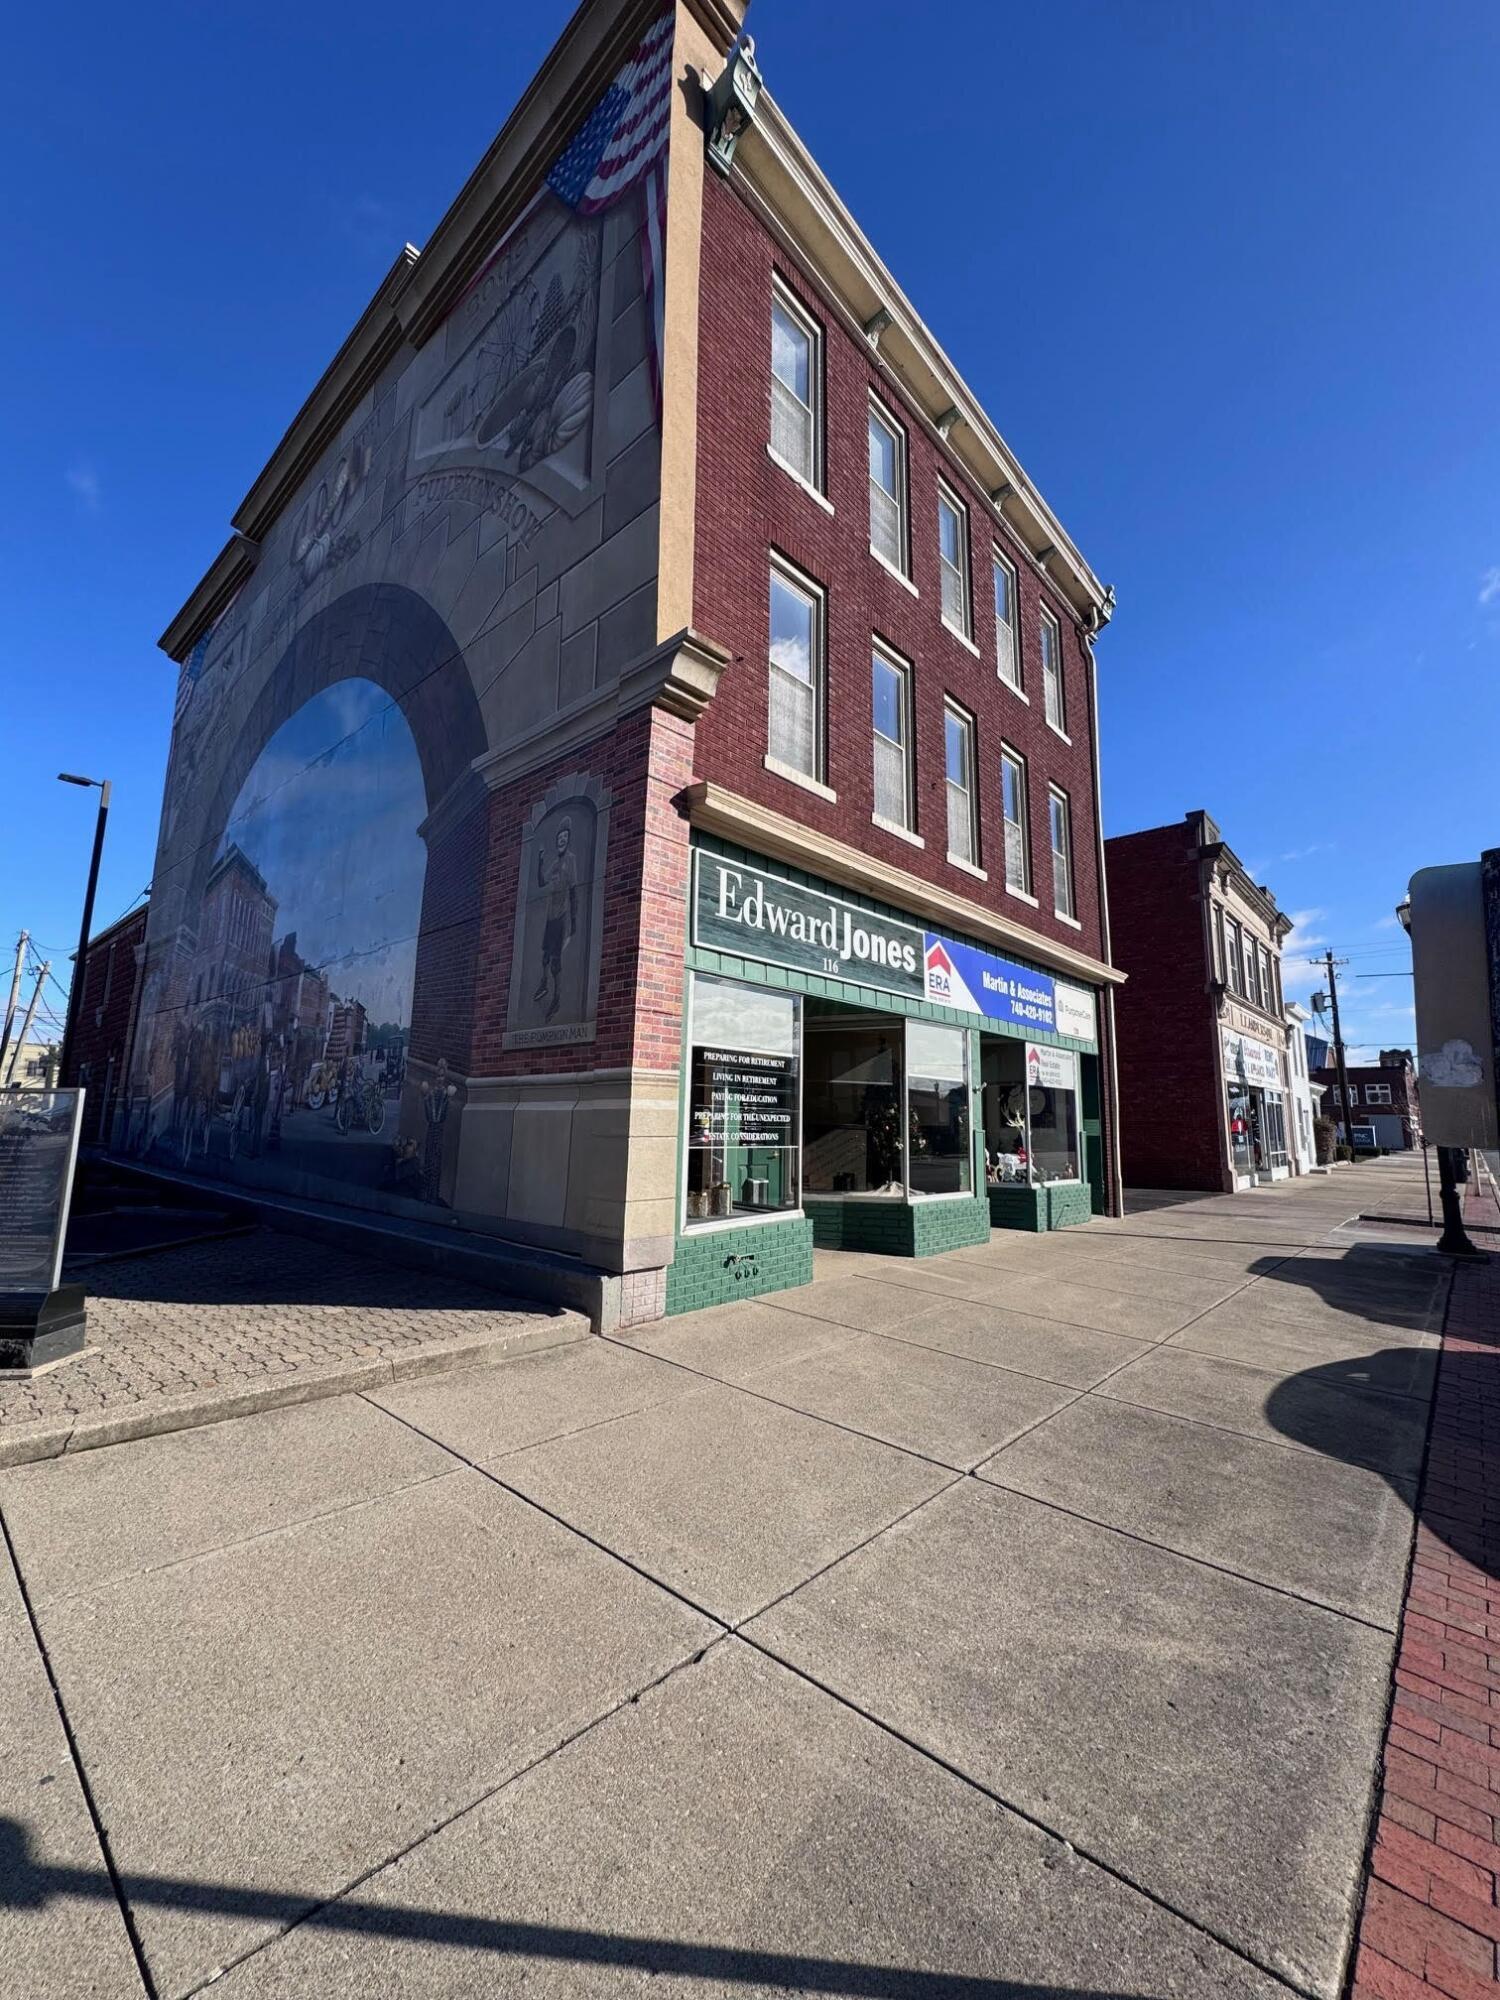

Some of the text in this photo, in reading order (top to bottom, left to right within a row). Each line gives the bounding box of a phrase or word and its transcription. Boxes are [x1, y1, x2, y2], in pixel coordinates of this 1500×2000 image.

[823, 957, 839, 974] 116
[929, 973, 951, 992] ERA
[982, 971, 1052, 1007] Martin & Associates
[703, 1051, 785, 1068] PREPARING FOR RETIREMENT
[712, 1072, 777, 1085] LIVING IN RETIREMENT
[711, 1091, 733, 1101] PAYING
[746, 1094, 778, 1103] EDUCATION
[694, 1111, 791, 1122] PREPARING FOR THE UNEXPECTED
[708, 1132, 779, 1141] ESTATE CONSIDERATIONS
